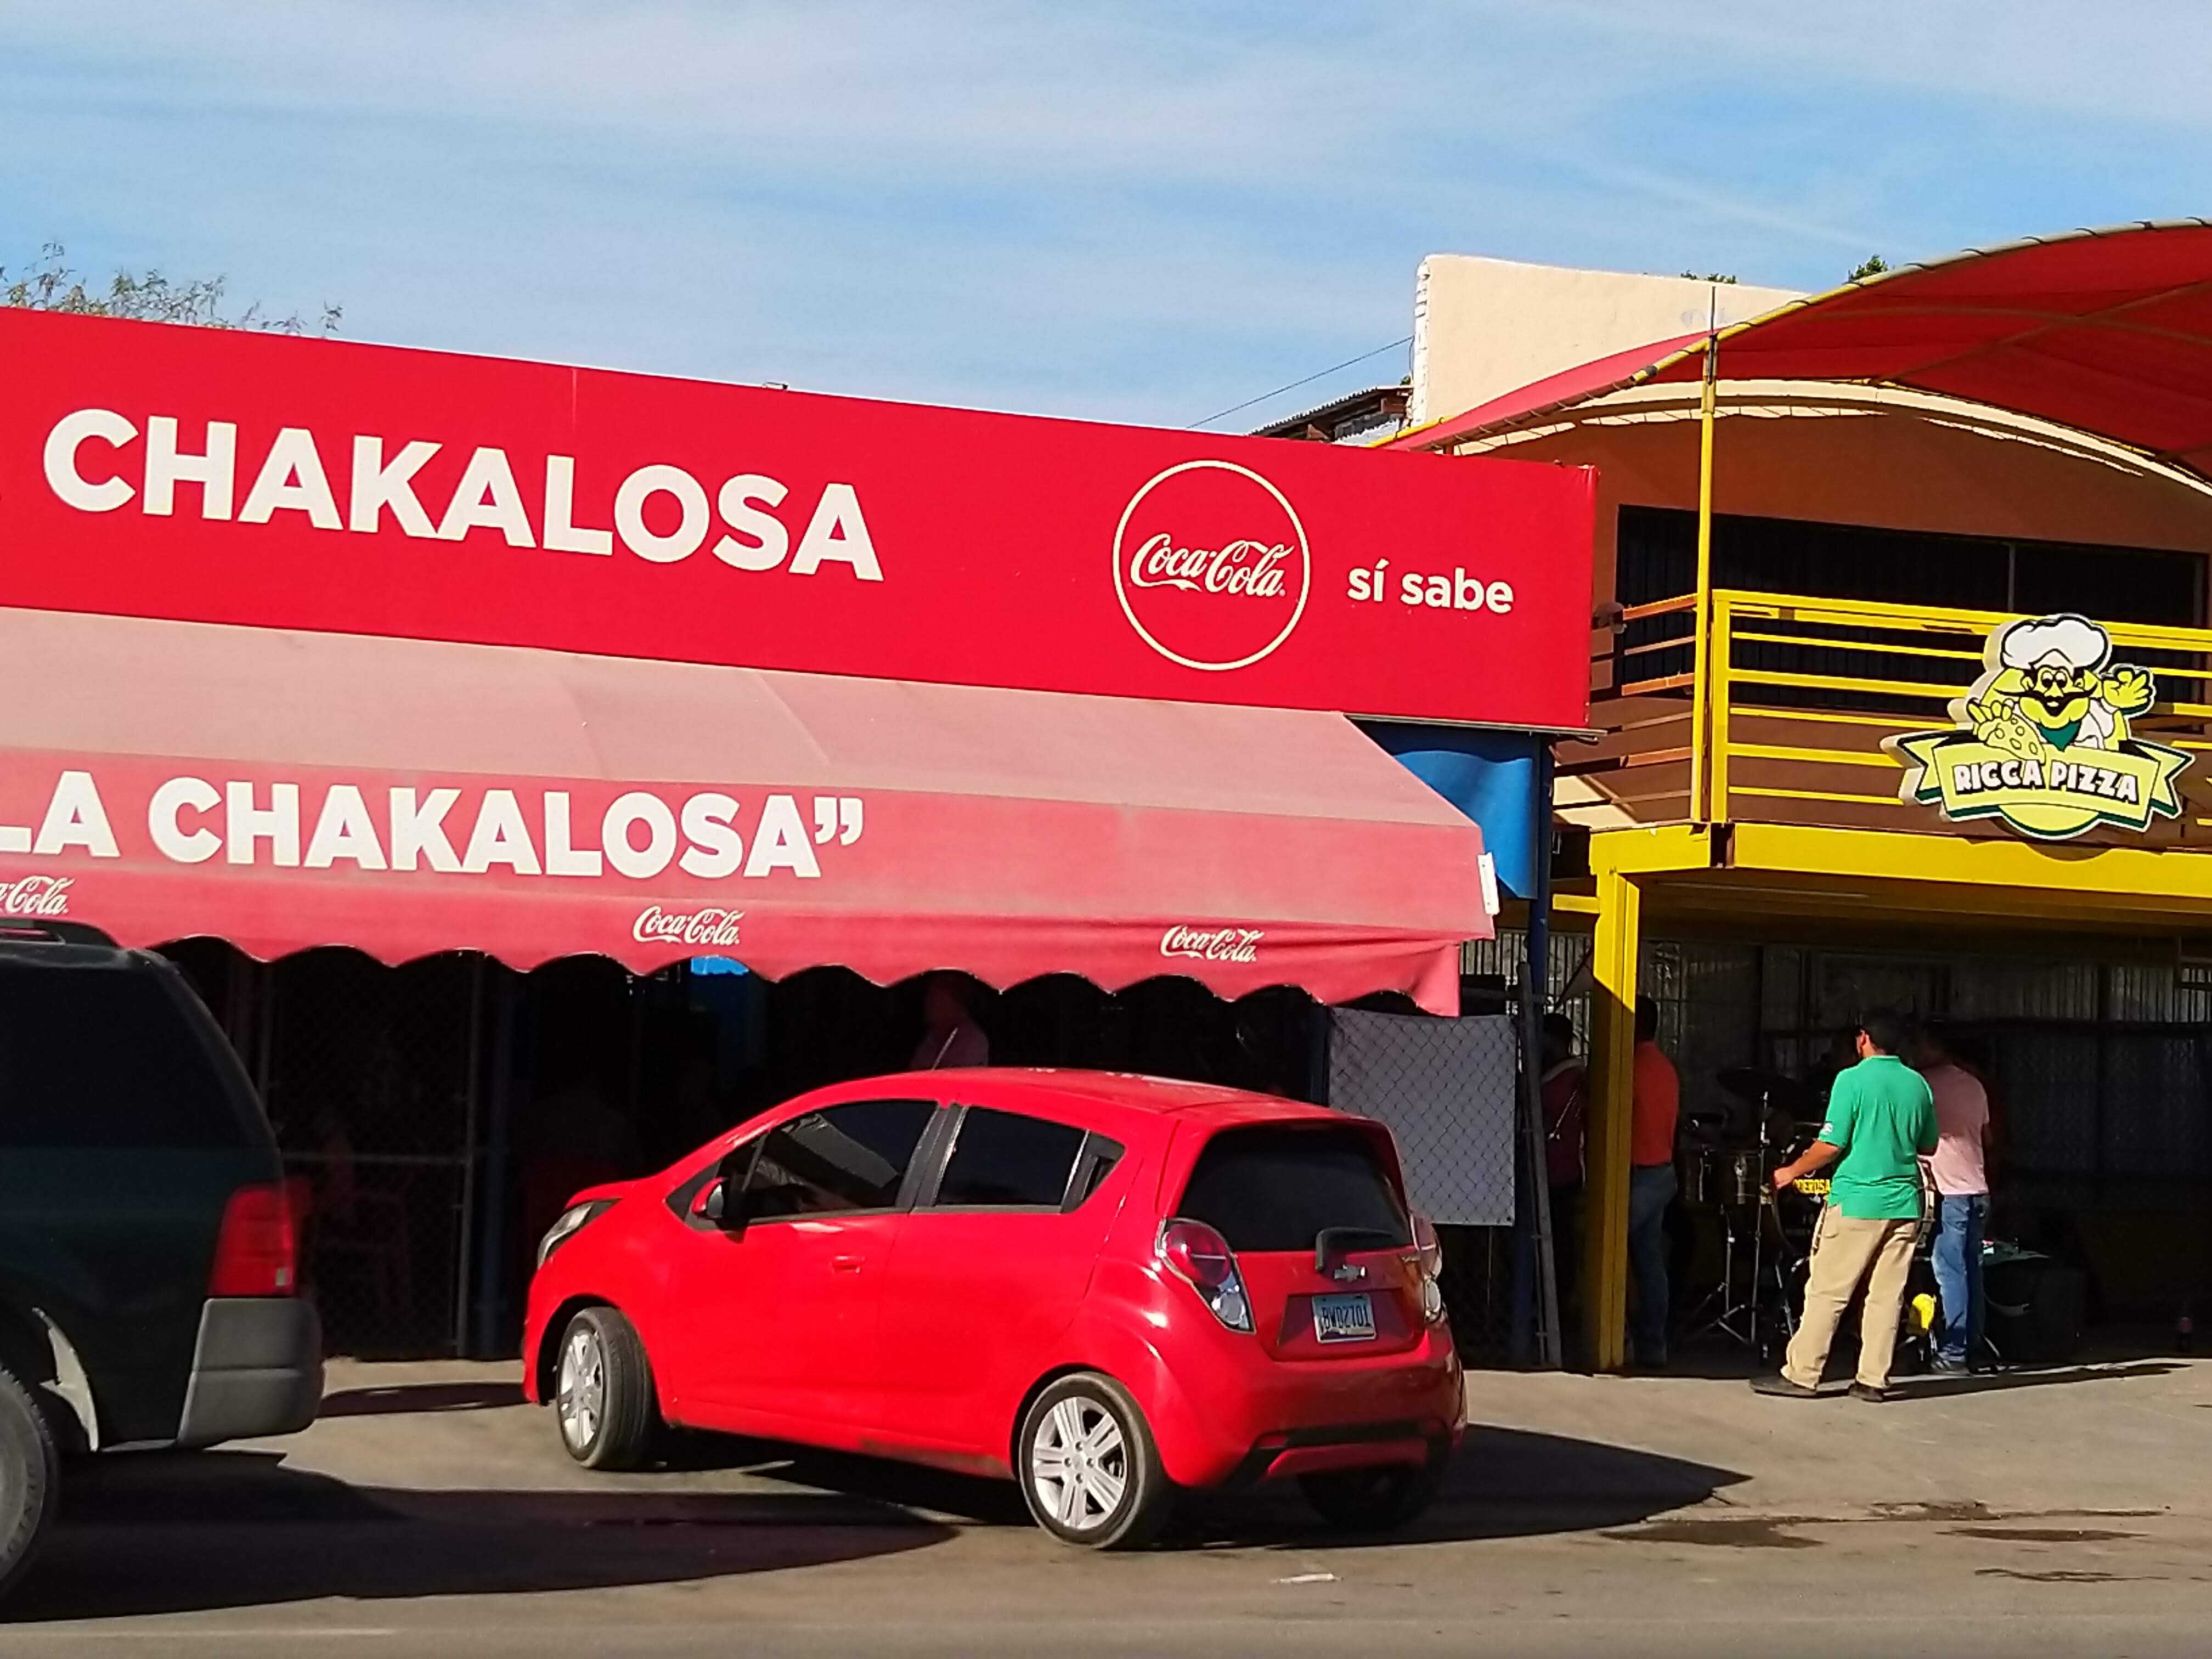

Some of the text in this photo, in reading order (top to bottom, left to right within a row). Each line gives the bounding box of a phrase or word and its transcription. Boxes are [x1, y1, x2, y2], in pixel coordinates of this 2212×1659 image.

[43, 408, 884, 582] CHAKALOSA
[1130, 533, 1295, 597] Coca-Cola
[1347, 558, 1514, 613] sí sabe
[1954, 760, 2140, 805] RICCA PIZZA
[633, 906, 745, 945] Coca-Cola
[1160, 924, 1265, 963] Coca-Cola
